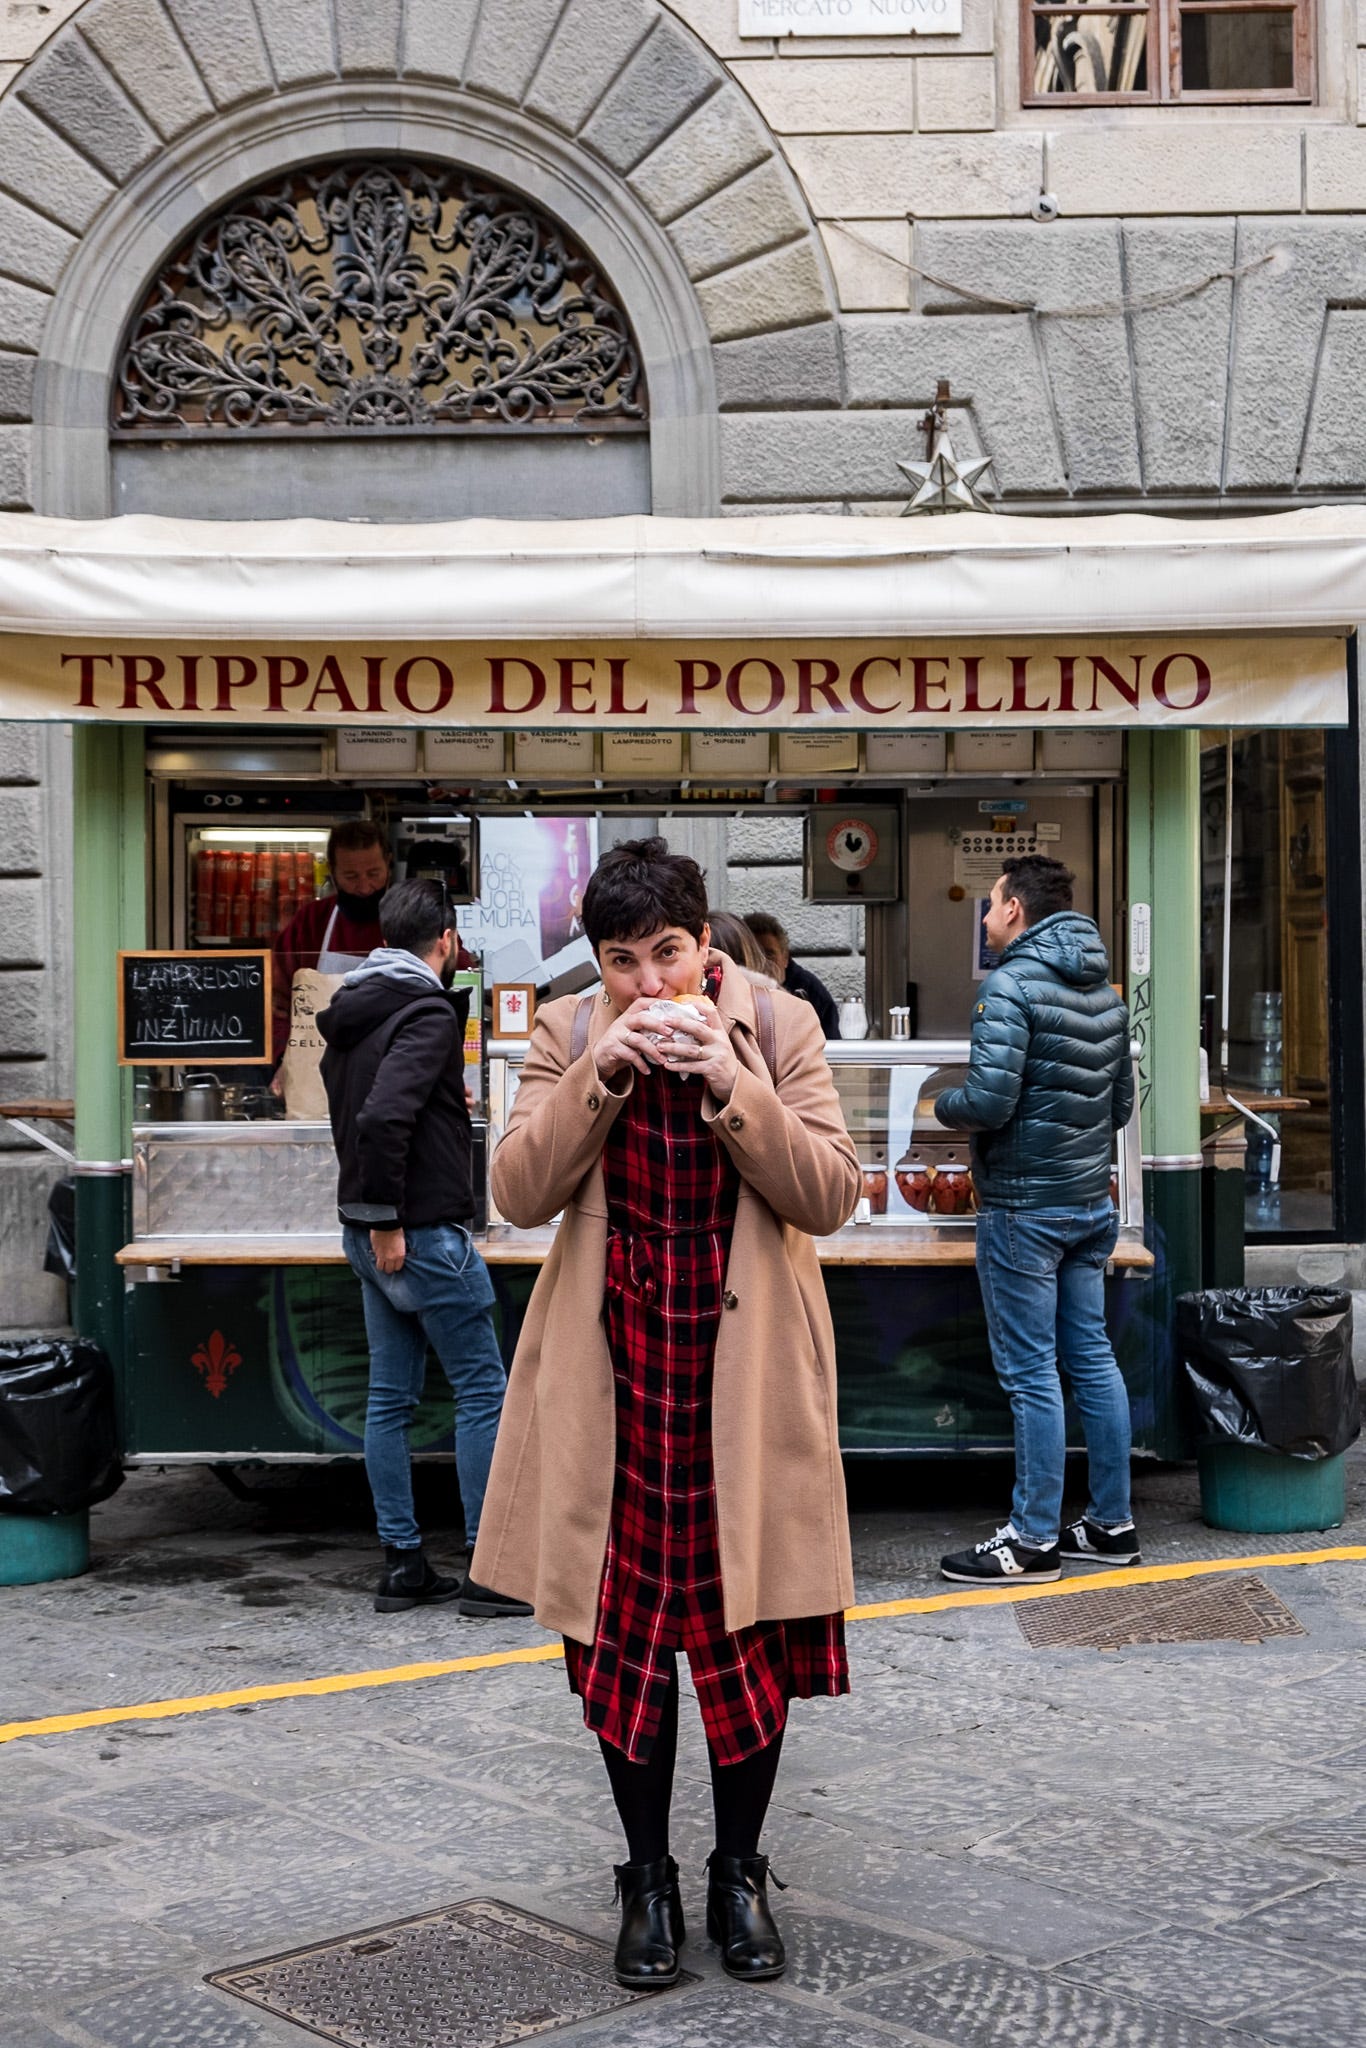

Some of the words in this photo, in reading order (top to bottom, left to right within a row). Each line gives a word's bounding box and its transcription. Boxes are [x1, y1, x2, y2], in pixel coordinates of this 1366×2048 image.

[752, 0, 852, 16] MERCATO
[870, 0, 946, 15] NUOVO
[61, 653, 454, 713] TRIPPAIO
[483, 657, 648, 714] DEL
[674, 653, 1212, 715] PORCELLINO
[480, 908, 536, 928] MURA
[132, 963, 262, 991] LAMPREDOTTO
[171, 996, 190, 1017] A
